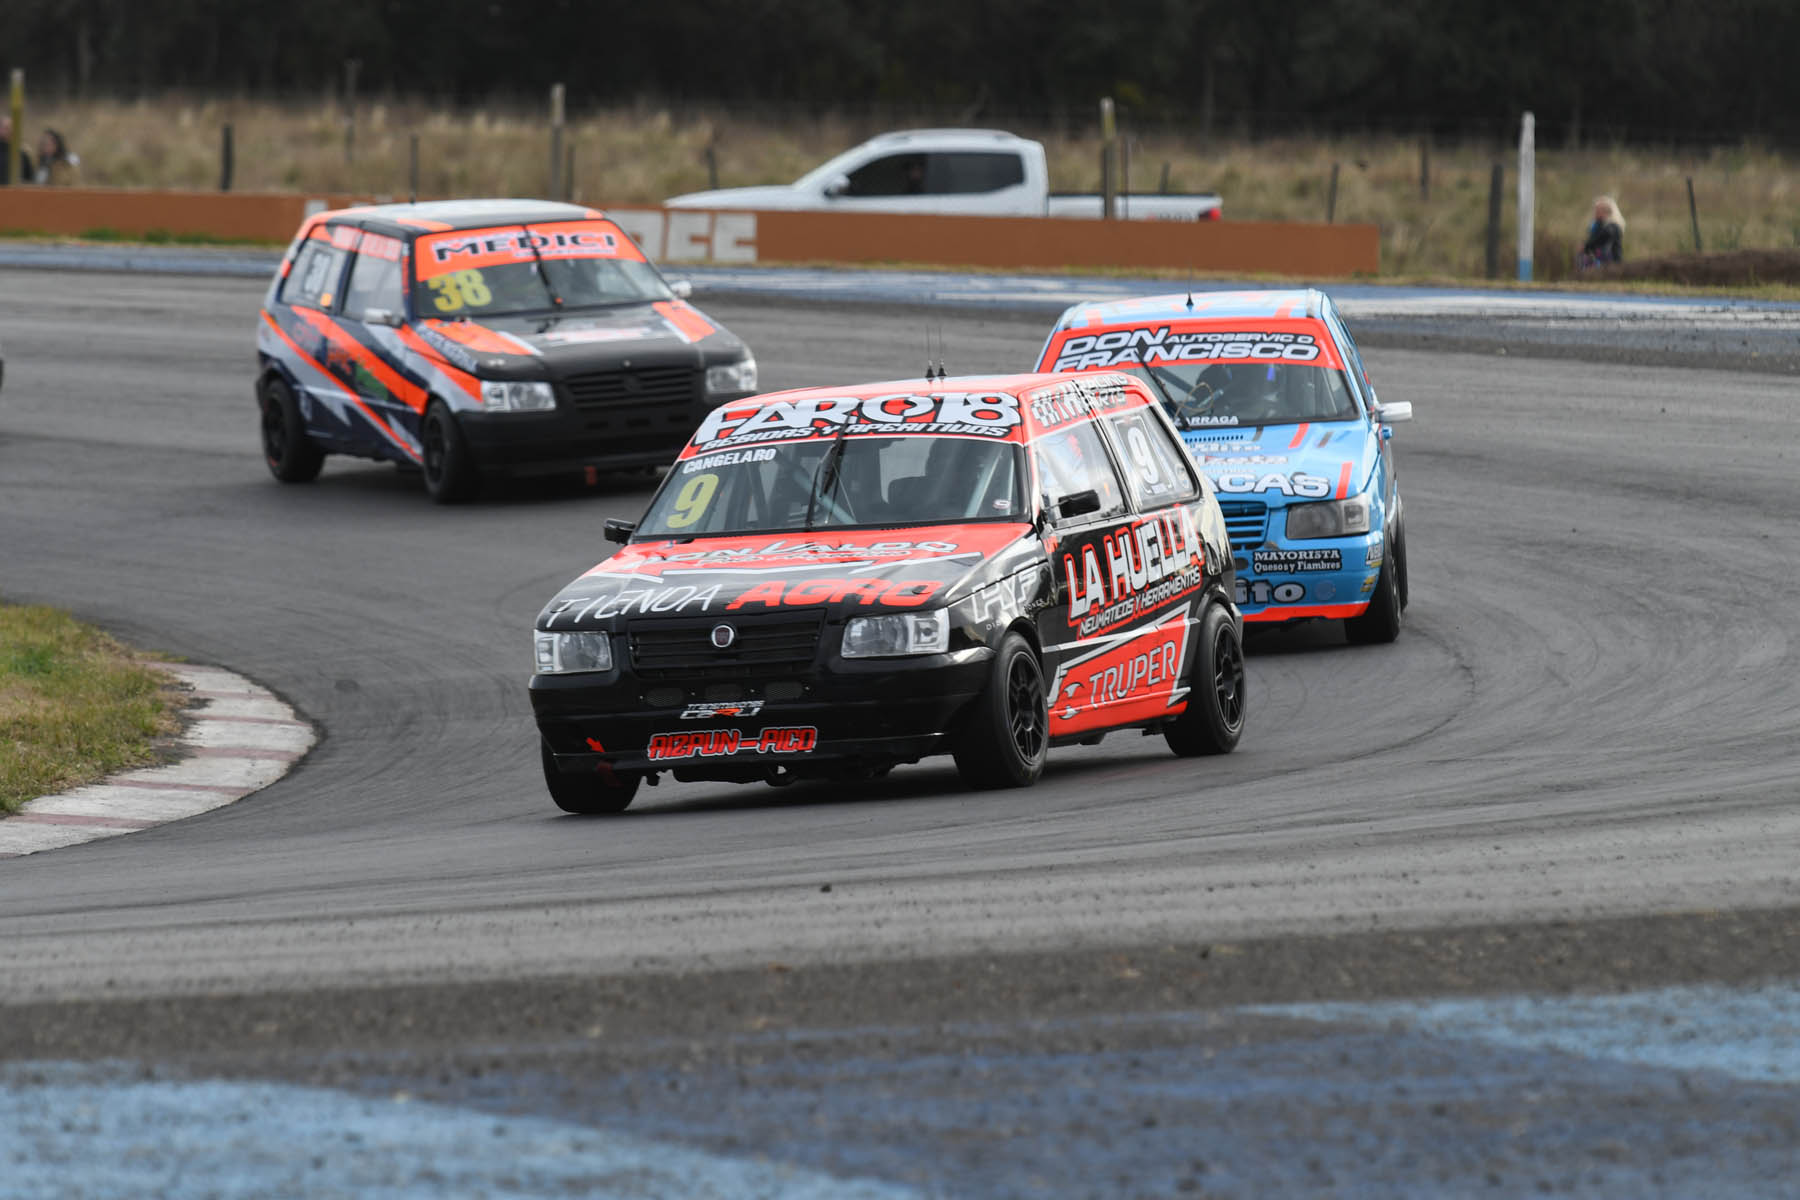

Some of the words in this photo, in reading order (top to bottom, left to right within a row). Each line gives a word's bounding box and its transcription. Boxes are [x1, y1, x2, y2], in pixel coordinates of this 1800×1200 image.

[432, 230, 618, 264] MEDICI
[428, 268, 493, 312] 38
[1052, 342, 1320, 373] FRANCISCO
[1061, 326, 1170, 357] DON
[699, 426, 817, 453] BEBIDAS
[844, 422, 1010, 437] APERITIVOS
[1127, 426, 1159, 485] 9
[683, 448, 777, 474] CANGELARO
[666, 473, 720, 529] 9
[1064, 547, 1107, 621] LA
[1104, 503, 1204, 602] HUELLA
[1254, 549, 1341, 562] MAYORISTA
[1254, 561, 1289, 574] Quesos
[1297, 560, 1342, 572] Fiambres
[545, 583, 724, 628] TIENDA
[724, 577, 945, 608] AGRO
[1078, 597, 1135, 637] NEUMATICOS
[1140, 566, 1202, 610] HERRAMIENTAS
[1088, 639, 1177, 709] TRUPER
